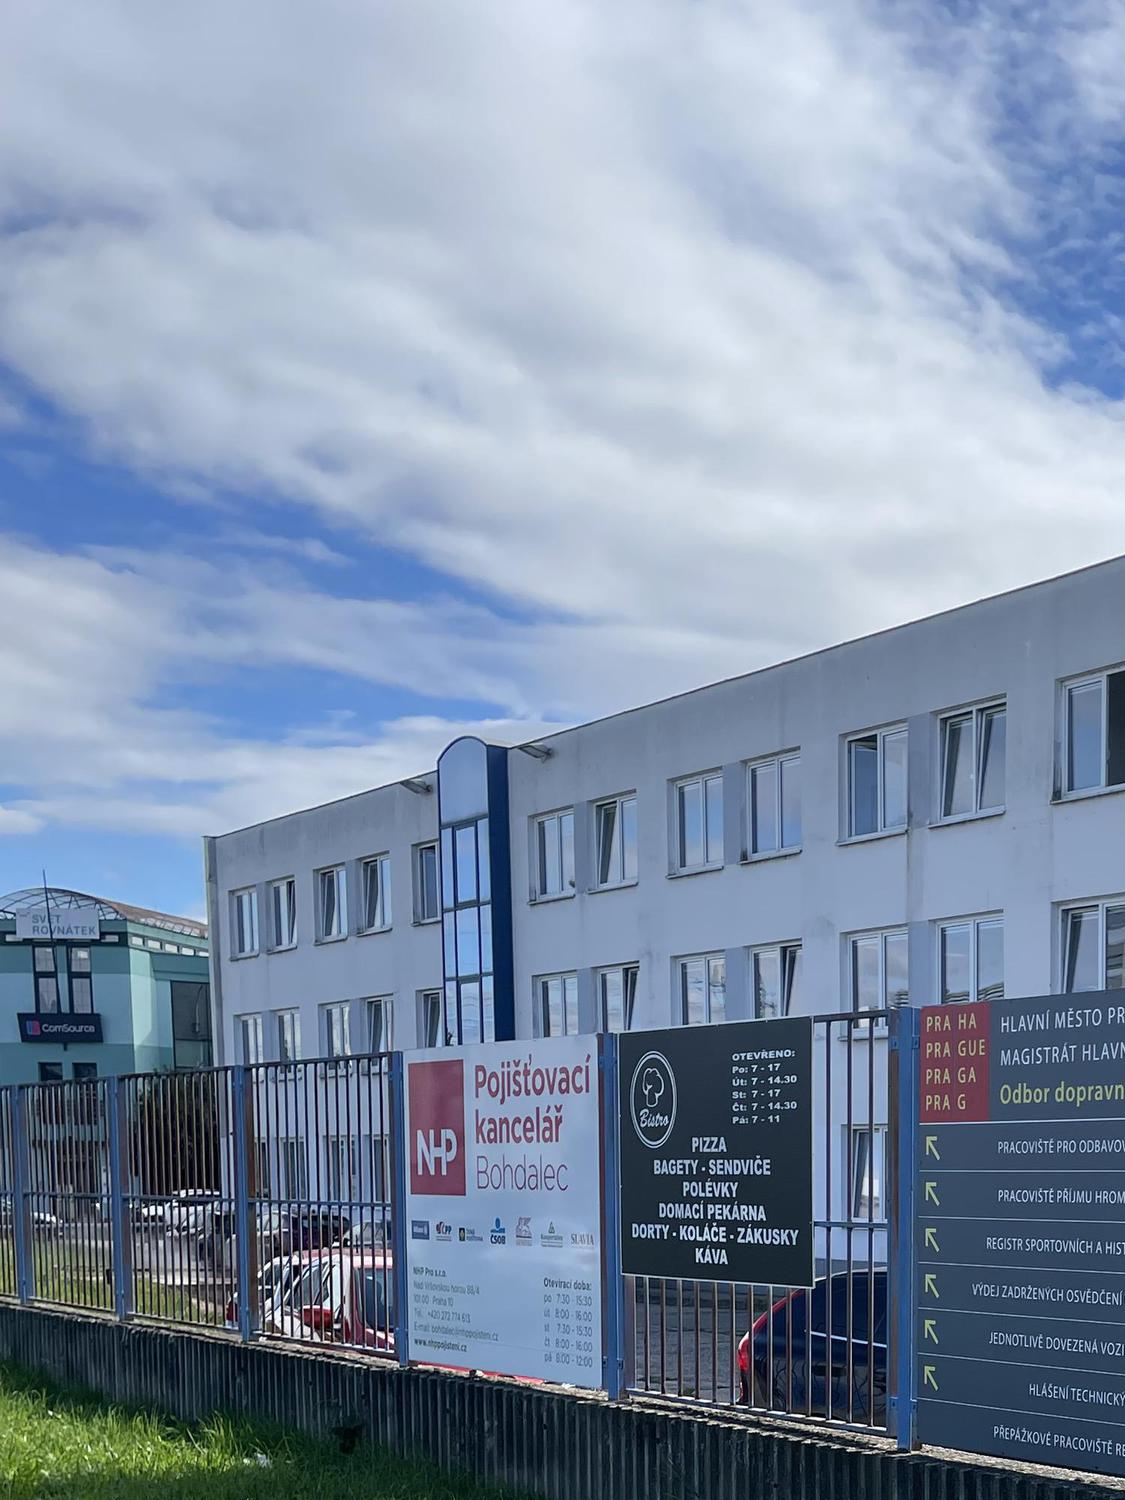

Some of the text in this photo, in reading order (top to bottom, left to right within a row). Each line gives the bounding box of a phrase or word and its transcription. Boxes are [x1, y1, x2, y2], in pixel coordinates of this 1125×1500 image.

[42, 1024, 95, 1033] ComSource
[926, 1013, 977, 1033] PRA HA
[1001, 1010, 1049, 1033] HLAVNÍ
[1055, 1007, 1102, 1029] MĚSTO
[732, 1049, 796, 1062] OTEVŘENO:
[926, 1039, 986, 1059] PRA GUE
[1000, 1042, 1077, 1066] MAGISTRÁT
[732, 1063, 781, 1074] Po: 7 17
[925, 1067, 976, 1085] PRA GA
[475, 1053, 592, 1105] Pojišťovací
[732, 1074, 797, 1087] Út: 7 14.30
[732, 1088, 781, 1099] St: 7 17
[925, 1094, 966, 1111] PRA G
[1000, 1082, 1050, 1105] Odbor
[732, 1100, 797, 1112] Čt: 7 14.30
[475, 1104, 564, 1144] kancelář
[639, 1108, 670, 1128] Bistro
[732, 1114, 780, 1125] Pá: 7 11
[416, 1128, 458, 1176] NHP
[691, 1136, 727, 1152] PIZZA
[997, 1138, 1054, 1154] PRACOVIŠTĚ
[1056, 1140, 1077, 1153] PRO
[476, 1153, 569, 1191] Bohdalec
[653, 1155, 771, 1175] BAGETY SENDVIČE
[682, 1178, 738, 1198] POLÉVKY
[998, 1187, 1054, 1203] PRACOVIŠTĚ
[1056, 1187, 1092, 1203] PŘÍJMU
[707, 1201, 767, 1221] PEKÁRNA
[571, 1233, 595, 1246] SLAVIA
[631, 1222, 799, 1246] DORTY KOLÁČE ZÁKUSKY
[695, 1244, 729, 1265] KÁVA
[986, 1237, 1023, 1251] REGISTR
[1025, 1237, 1093, 1254] SPORTOVNÍCH
[1095, 1241, 1102, 1254] A
[971, 1282, 1000, 1297] VÝDEJ
[1001, 1285, 1064, 1303] ZADRŽENÝCH
[1066, 1287, 1123, 1306] OSVĚDČENÍ
[1046, 1336, 1099, 1354] DOVEZENÁ
[1029, 1382, 1069, 1400] HLÁŠENÍ
[1053, 1434, 1113, 1456] PRACOVIŠTĚ
